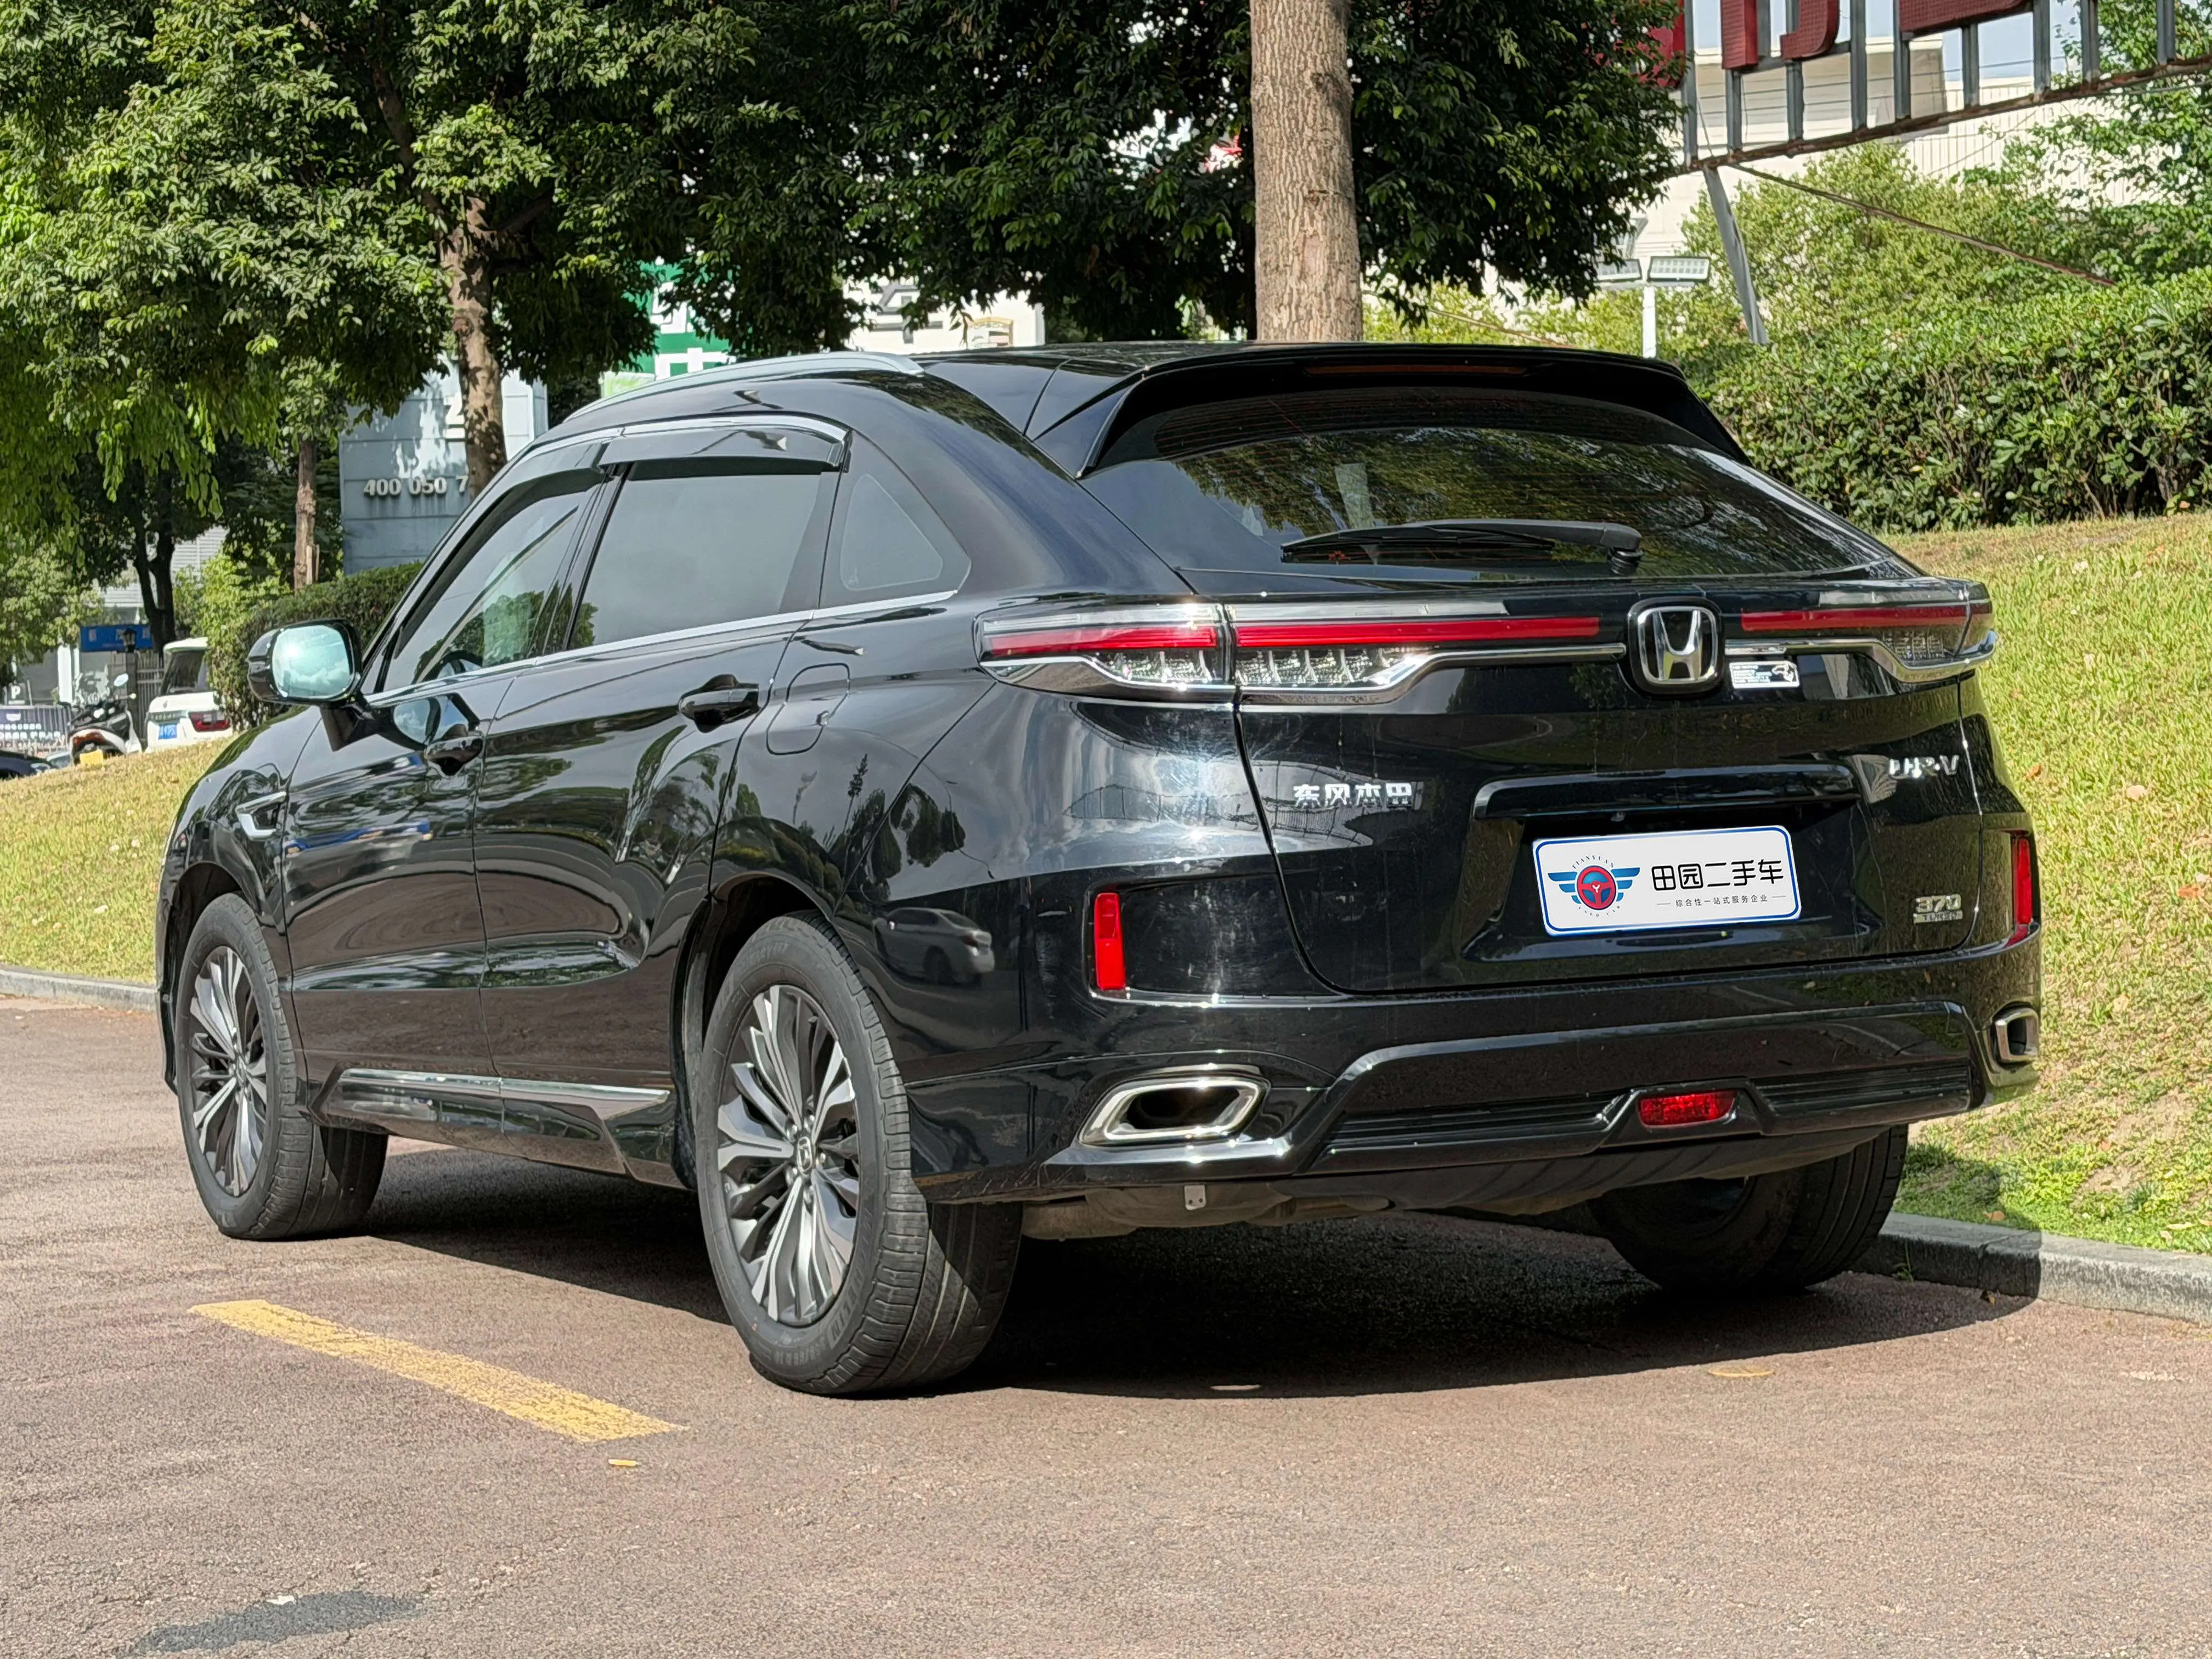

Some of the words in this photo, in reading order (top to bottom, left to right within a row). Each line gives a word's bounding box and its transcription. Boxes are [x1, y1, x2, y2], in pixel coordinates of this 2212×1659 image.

[363, 478, 402, 496] 400
[409, 477, 447, 494] 050
[1915, 894, 1961, 912] 370
